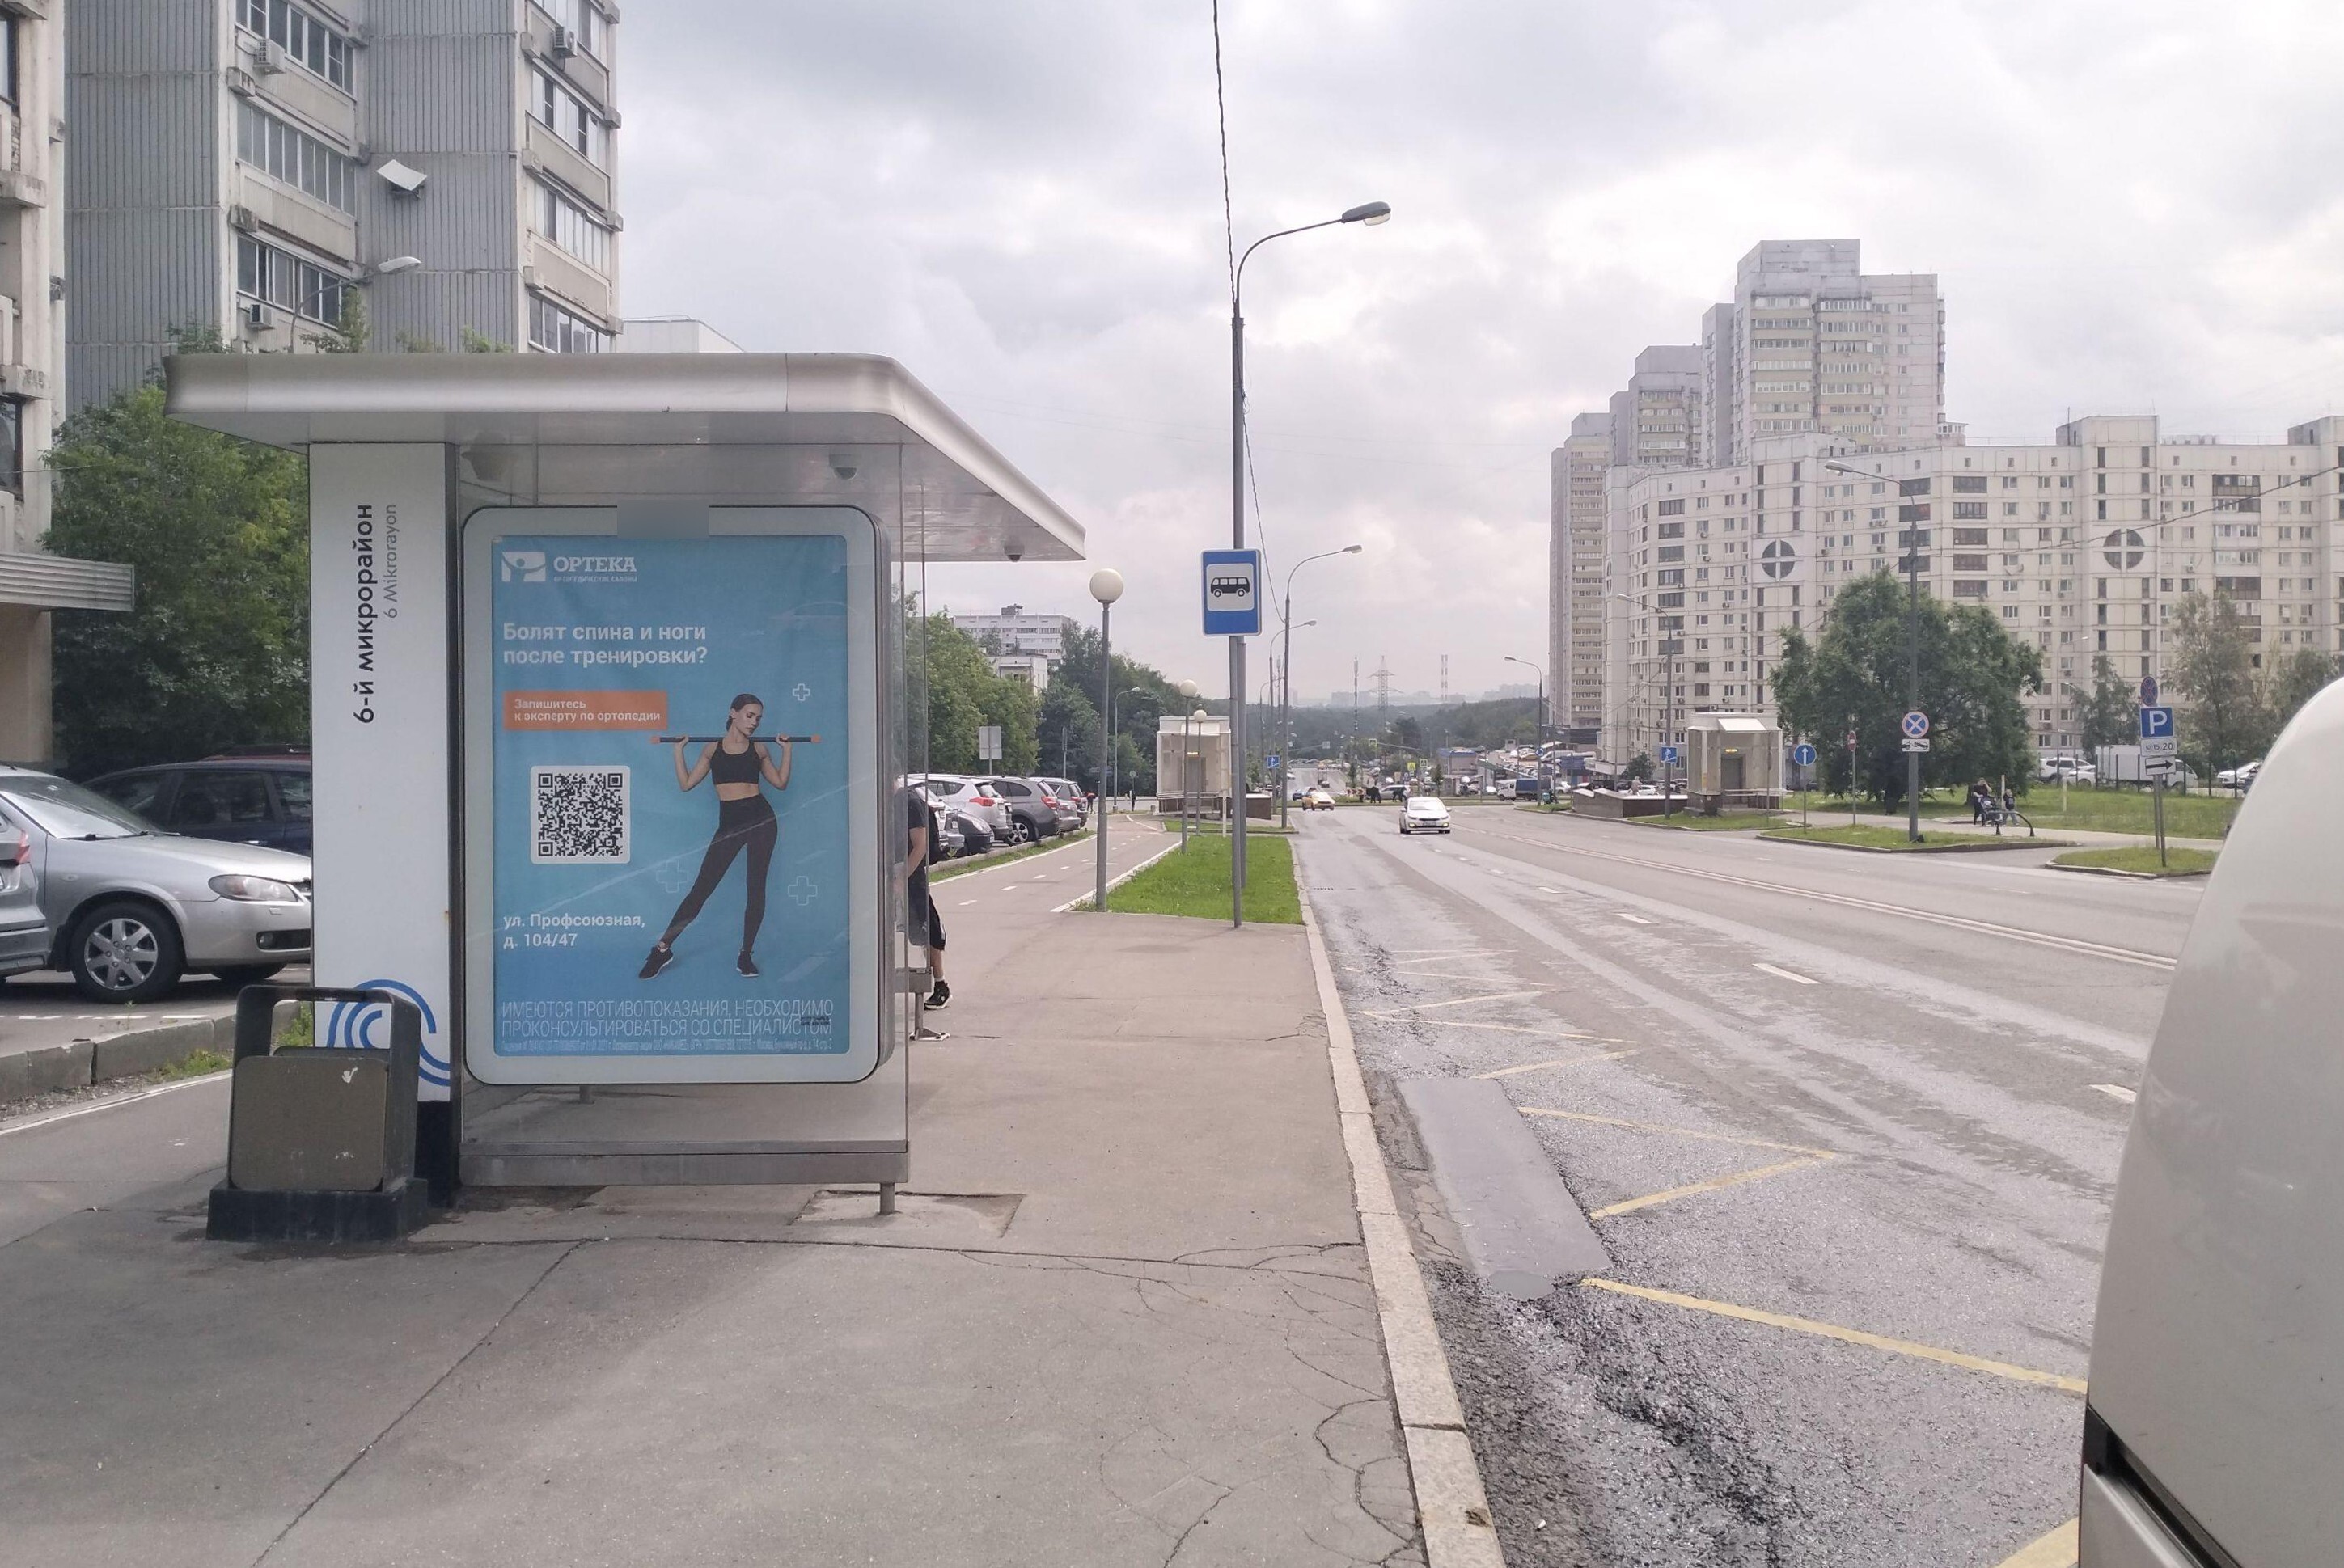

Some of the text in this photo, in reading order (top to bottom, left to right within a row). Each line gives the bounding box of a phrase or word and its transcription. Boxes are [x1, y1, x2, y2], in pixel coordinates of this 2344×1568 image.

[383, 504, 400, 619] 6 Mikrorayon
[553, 556, 637, 573] ОРТЕКА
[352, 505, 378, 723] 6-й микрорайон
[503, 623, 706, 640] Болят спина и ноги
[503, 646, 708, 668] после тренировки?
[514, 698, 586, 709] Запишитесь
[524, 712, 577, 724] эксперту
[580, 712, 594, 721] по
[597, 712, 660, 723] ортопедии
[2149, 710, 2168, 735] P
[2163, 742, 2173, 750] 20
[503, 913, 646, 929] ул. Профсоюзная,
[503, 933, 578, 949] д. 104/47
[502, 1000, 834, 1020] ИМЕЮТСЯ ПРОТИВОПОКАЗАНИЯ, НЕОБХОДИМО
[502, 1019, 687, 1038] ПРОКОНСУЛЬТИРОВАТЬСЯ
[691, 1019, 710, 1036] СО
[713, 1018, 832, 1038] СПЕЦИАЛИСТОМ
